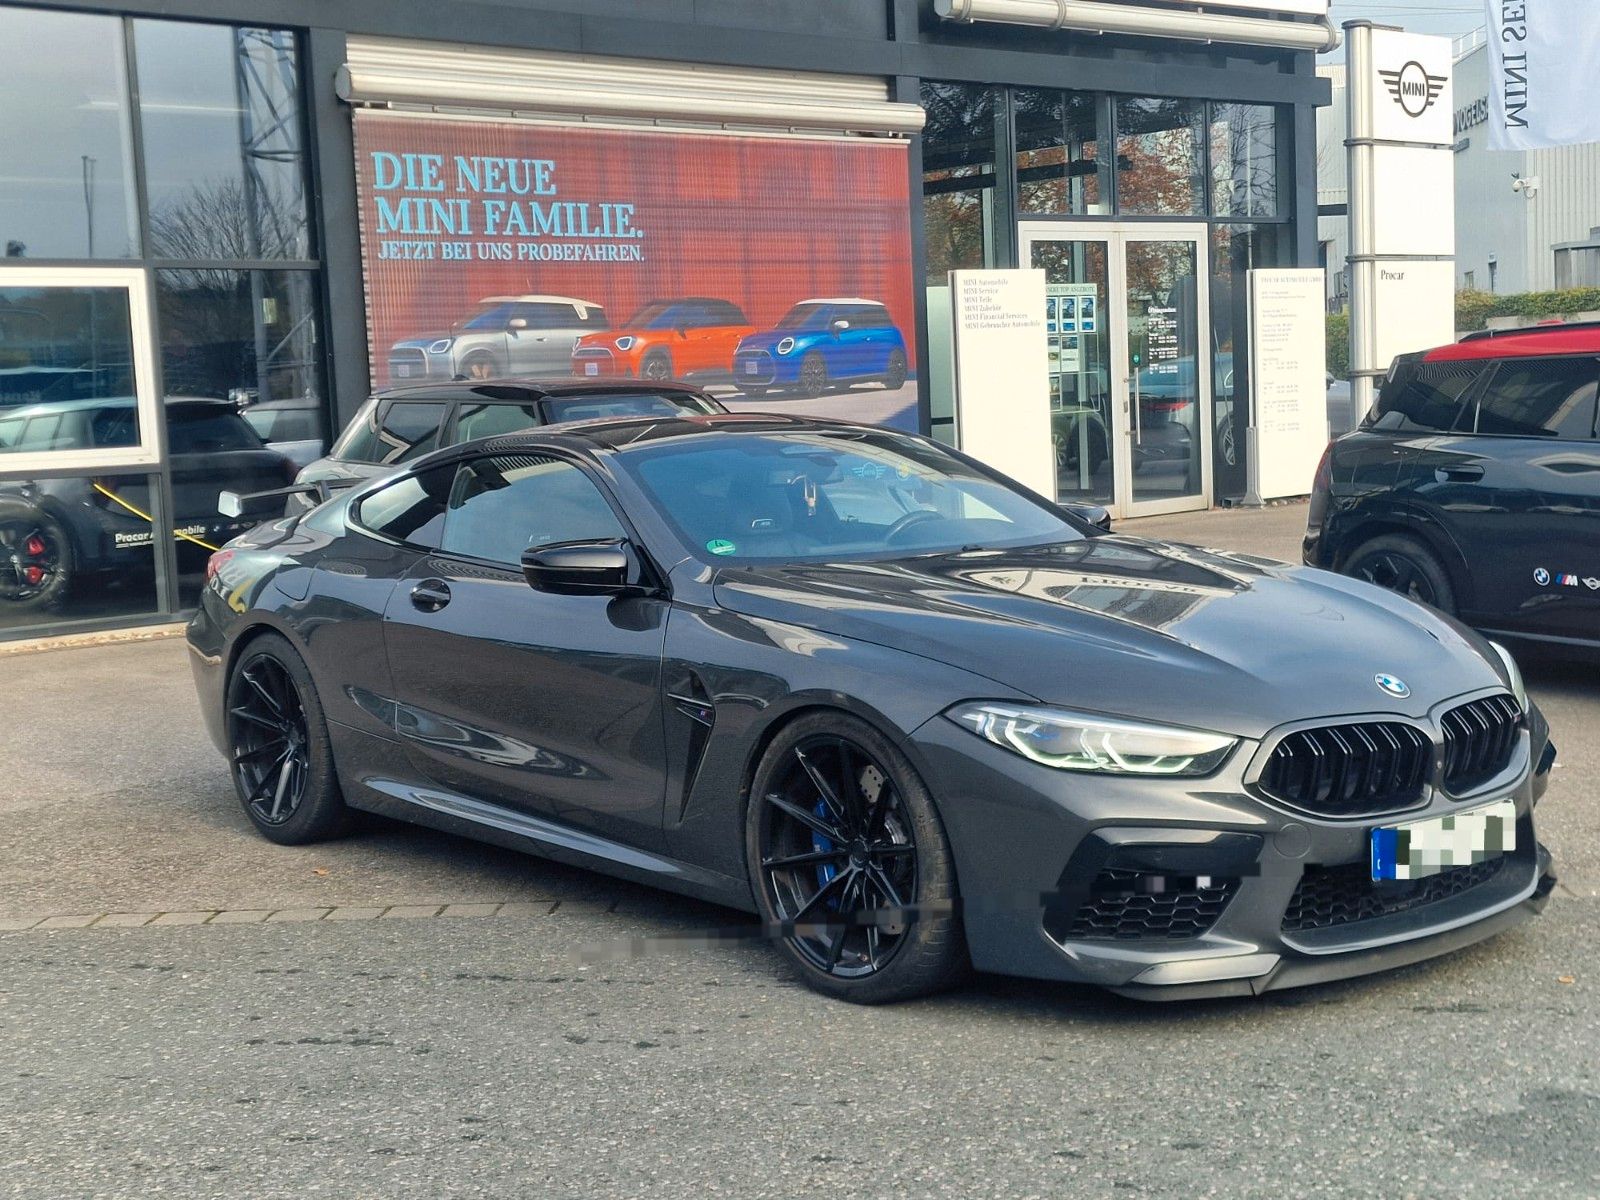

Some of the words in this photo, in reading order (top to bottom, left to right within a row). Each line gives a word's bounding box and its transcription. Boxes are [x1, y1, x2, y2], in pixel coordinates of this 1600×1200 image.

[1402, 81, 1425, 97] MINI
[371, 152, 444, 191] DIE
[454, 156, 556, 195] NEUE
[374, 196, 473, 235] MINI
[482, 200, 644, 238] FAMILIE.
[377, 240, 435, 260] JETZT
[441, 242, 473, 260] BEI
[476, 242, 513, 261] UNS
[517, 243, 645, 262] PROBEFAHREN.
[1380, 269, 1405, 281] Procar
[115, 532, 149, 543] Procar
